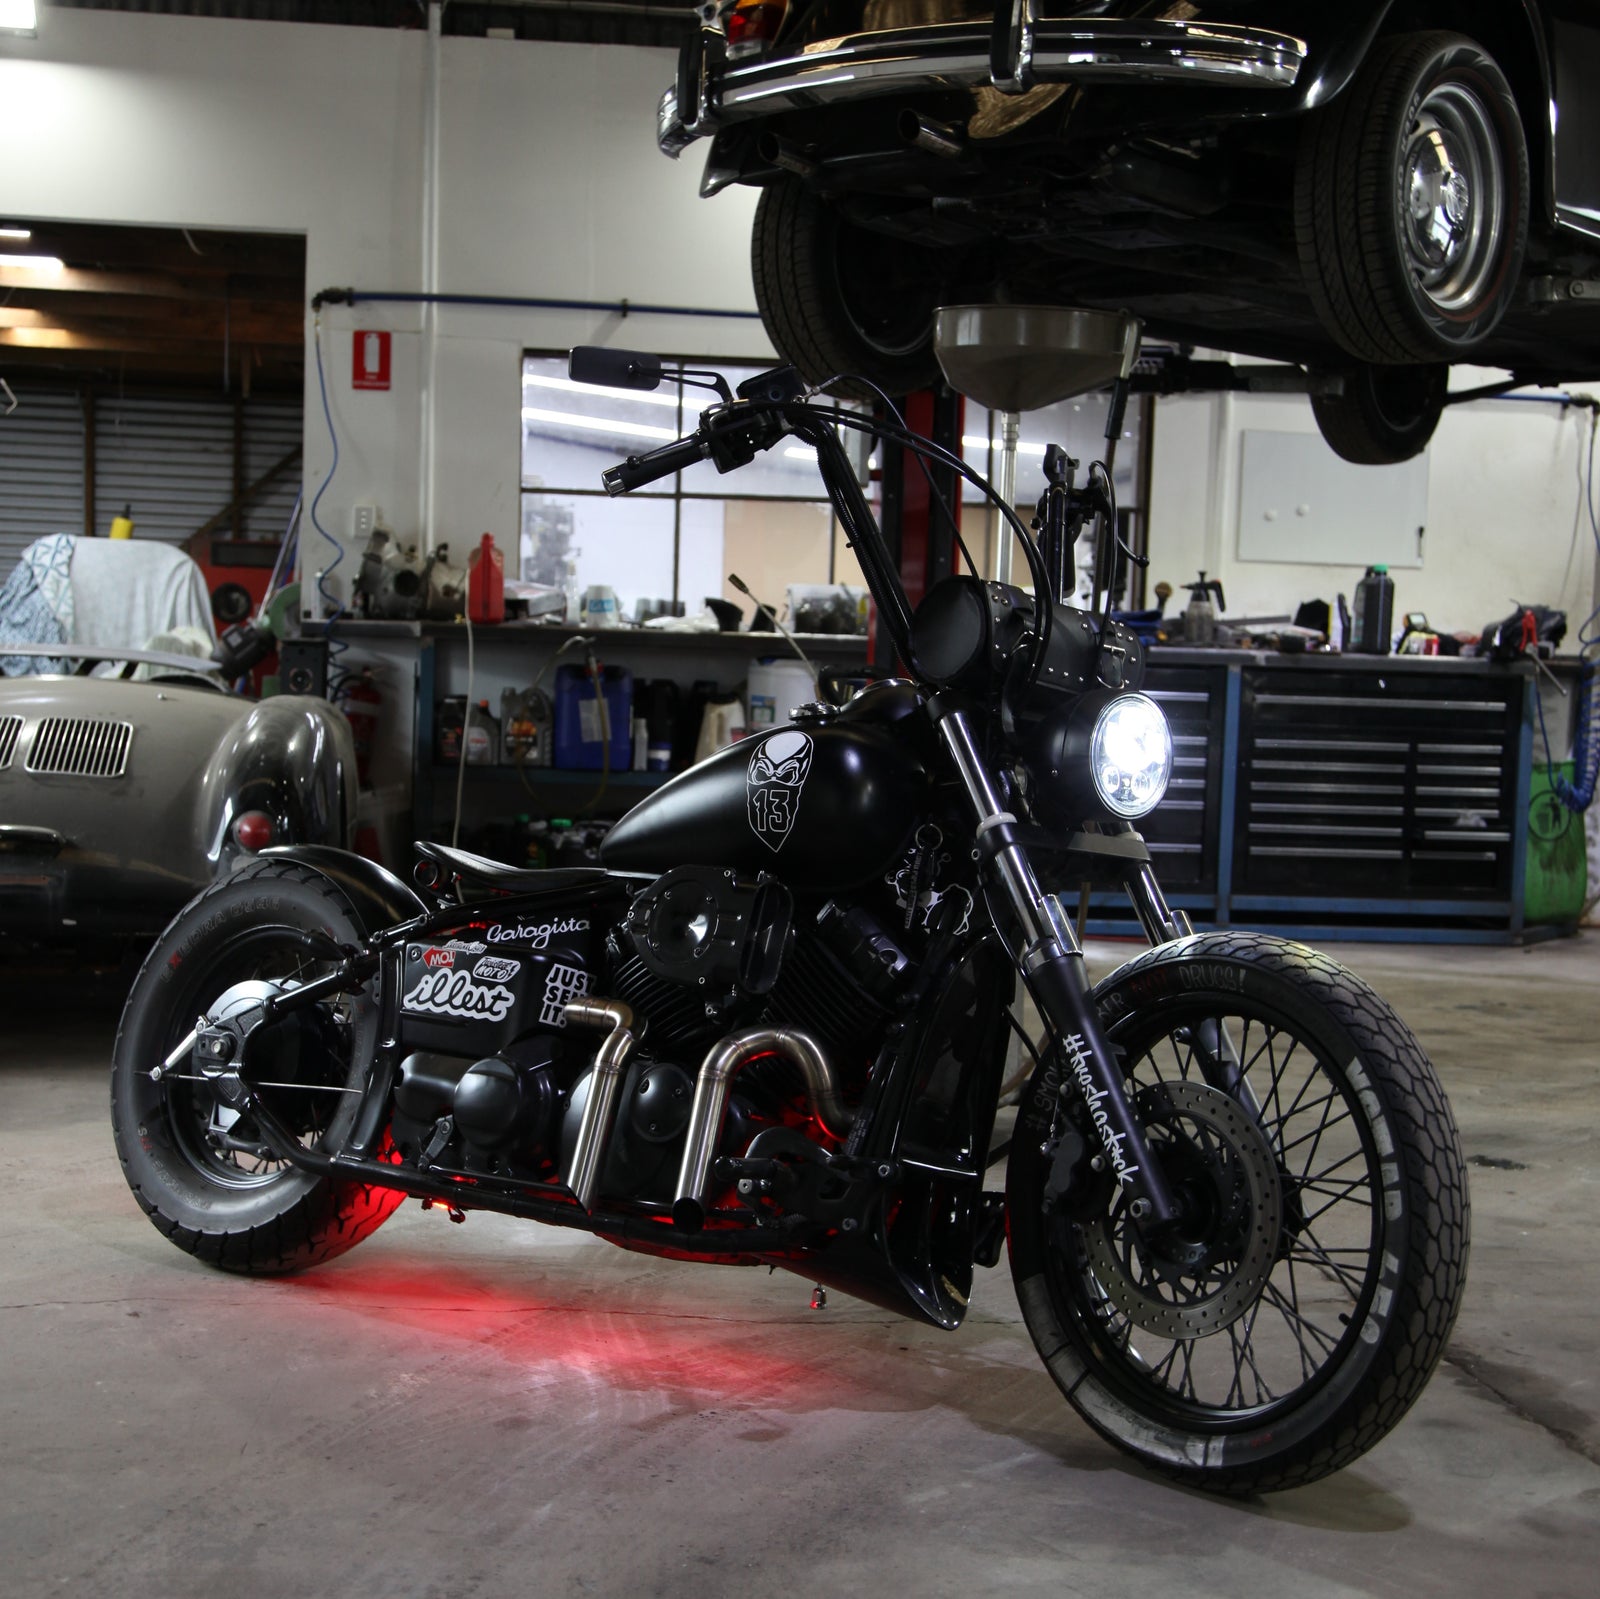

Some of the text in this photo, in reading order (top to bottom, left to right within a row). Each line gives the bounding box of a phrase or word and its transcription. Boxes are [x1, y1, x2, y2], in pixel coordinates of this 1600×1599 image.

[752, 788, 790, 832] 13
[486, 916, 590, 950] Garagista
[430, 950, 455, 966] TOW
[475, 964, 508, 980] MOTO
[548, 966, 595, 994] JUST
[1178, 962, 1248, 994] DRUGS!
[407, 971, 512, 1018] illest
